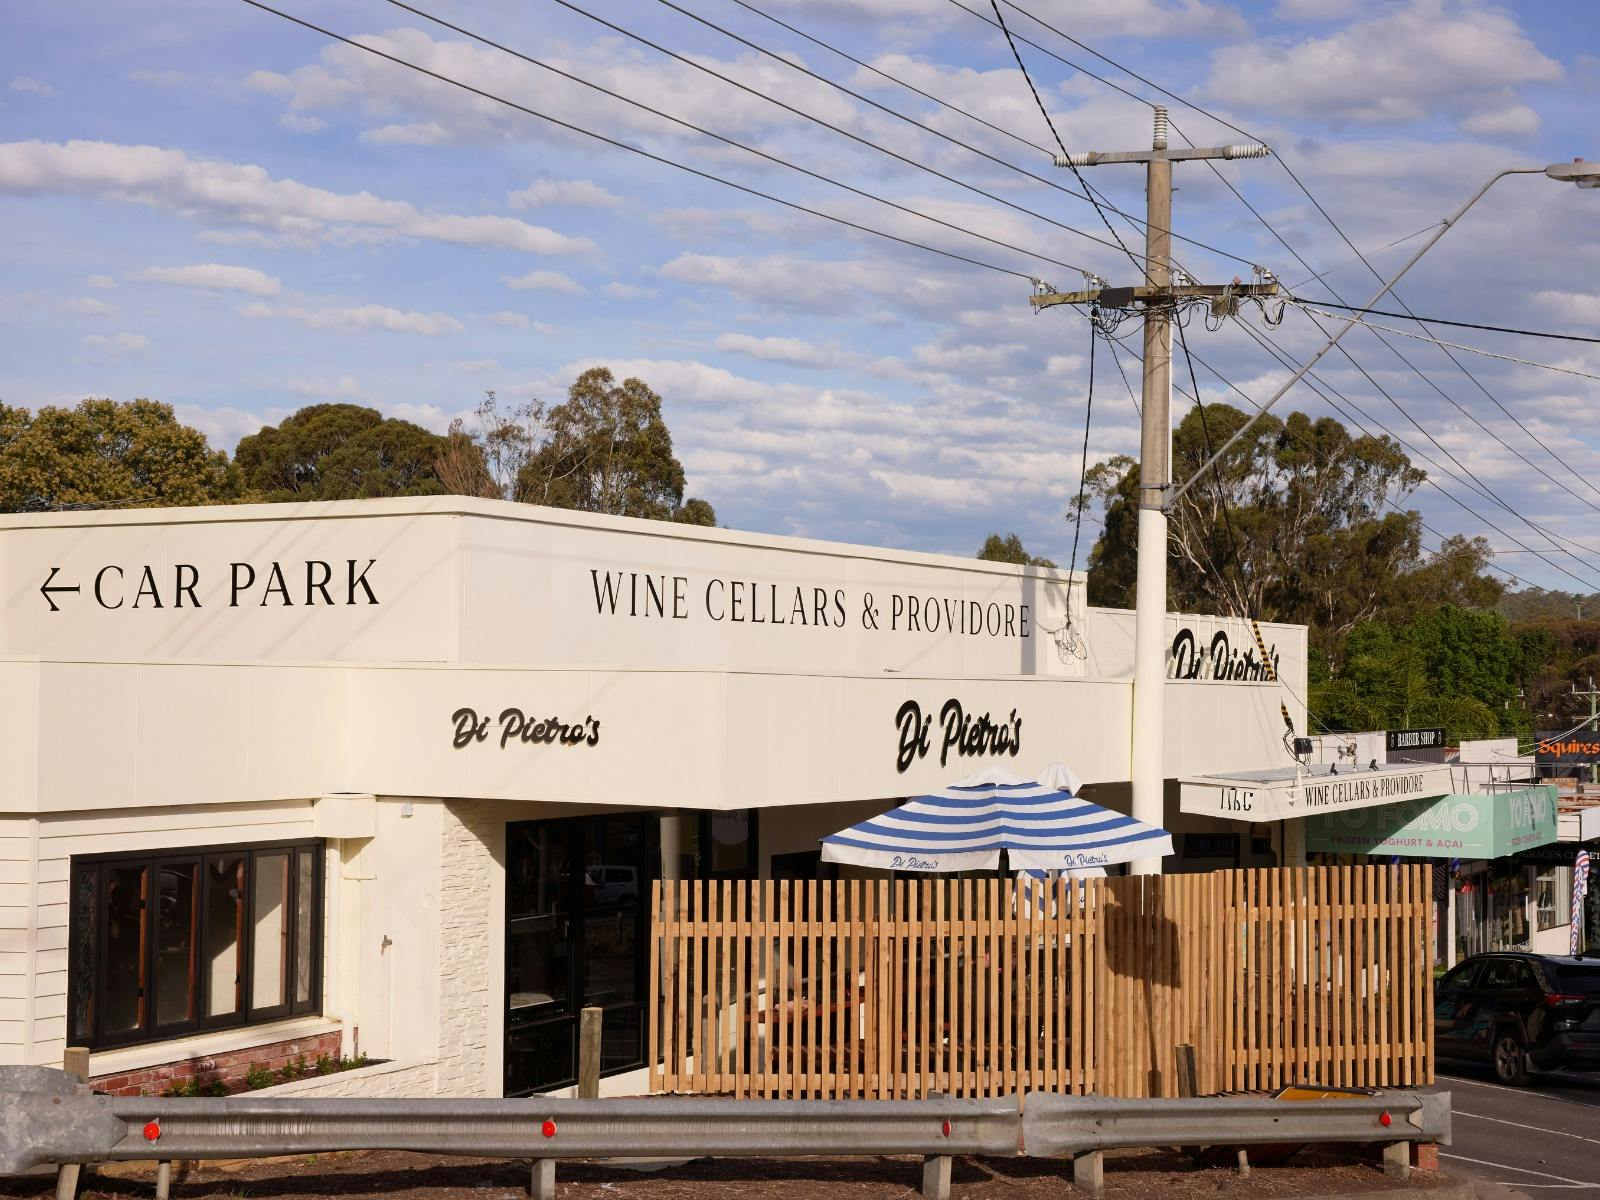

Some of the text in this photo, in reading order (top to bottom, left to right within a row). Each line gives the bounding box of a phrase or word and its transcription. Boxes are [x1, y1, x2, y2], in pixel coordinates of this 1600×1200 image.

[94, 559, 380, 610] CAR PARK
[590, 569, 1033, 641] WINE CELLARS & PROVIDORE
[452, 707, 601, 748] Di Pietro's
[895, 698, 1022, 773] Di Pietro's
[1398, 731, 1435, 746] BARBER SHOP
[1538, 736, 1600, 758] Squires
[1304, 774, 1424, 807] WINE CELLARS & PROVIDORE
[1377, 801, 1479, 832] FOMO
[1331, 835, 1370, 845] FROZEN
[1373, 837, 1422, 847] YOGHURT
[1425, 839, 1433, 847] &
[890, 855, 939, 869] Di Pietro's
[1064, 853, 1108, 867] Di Pietro's
